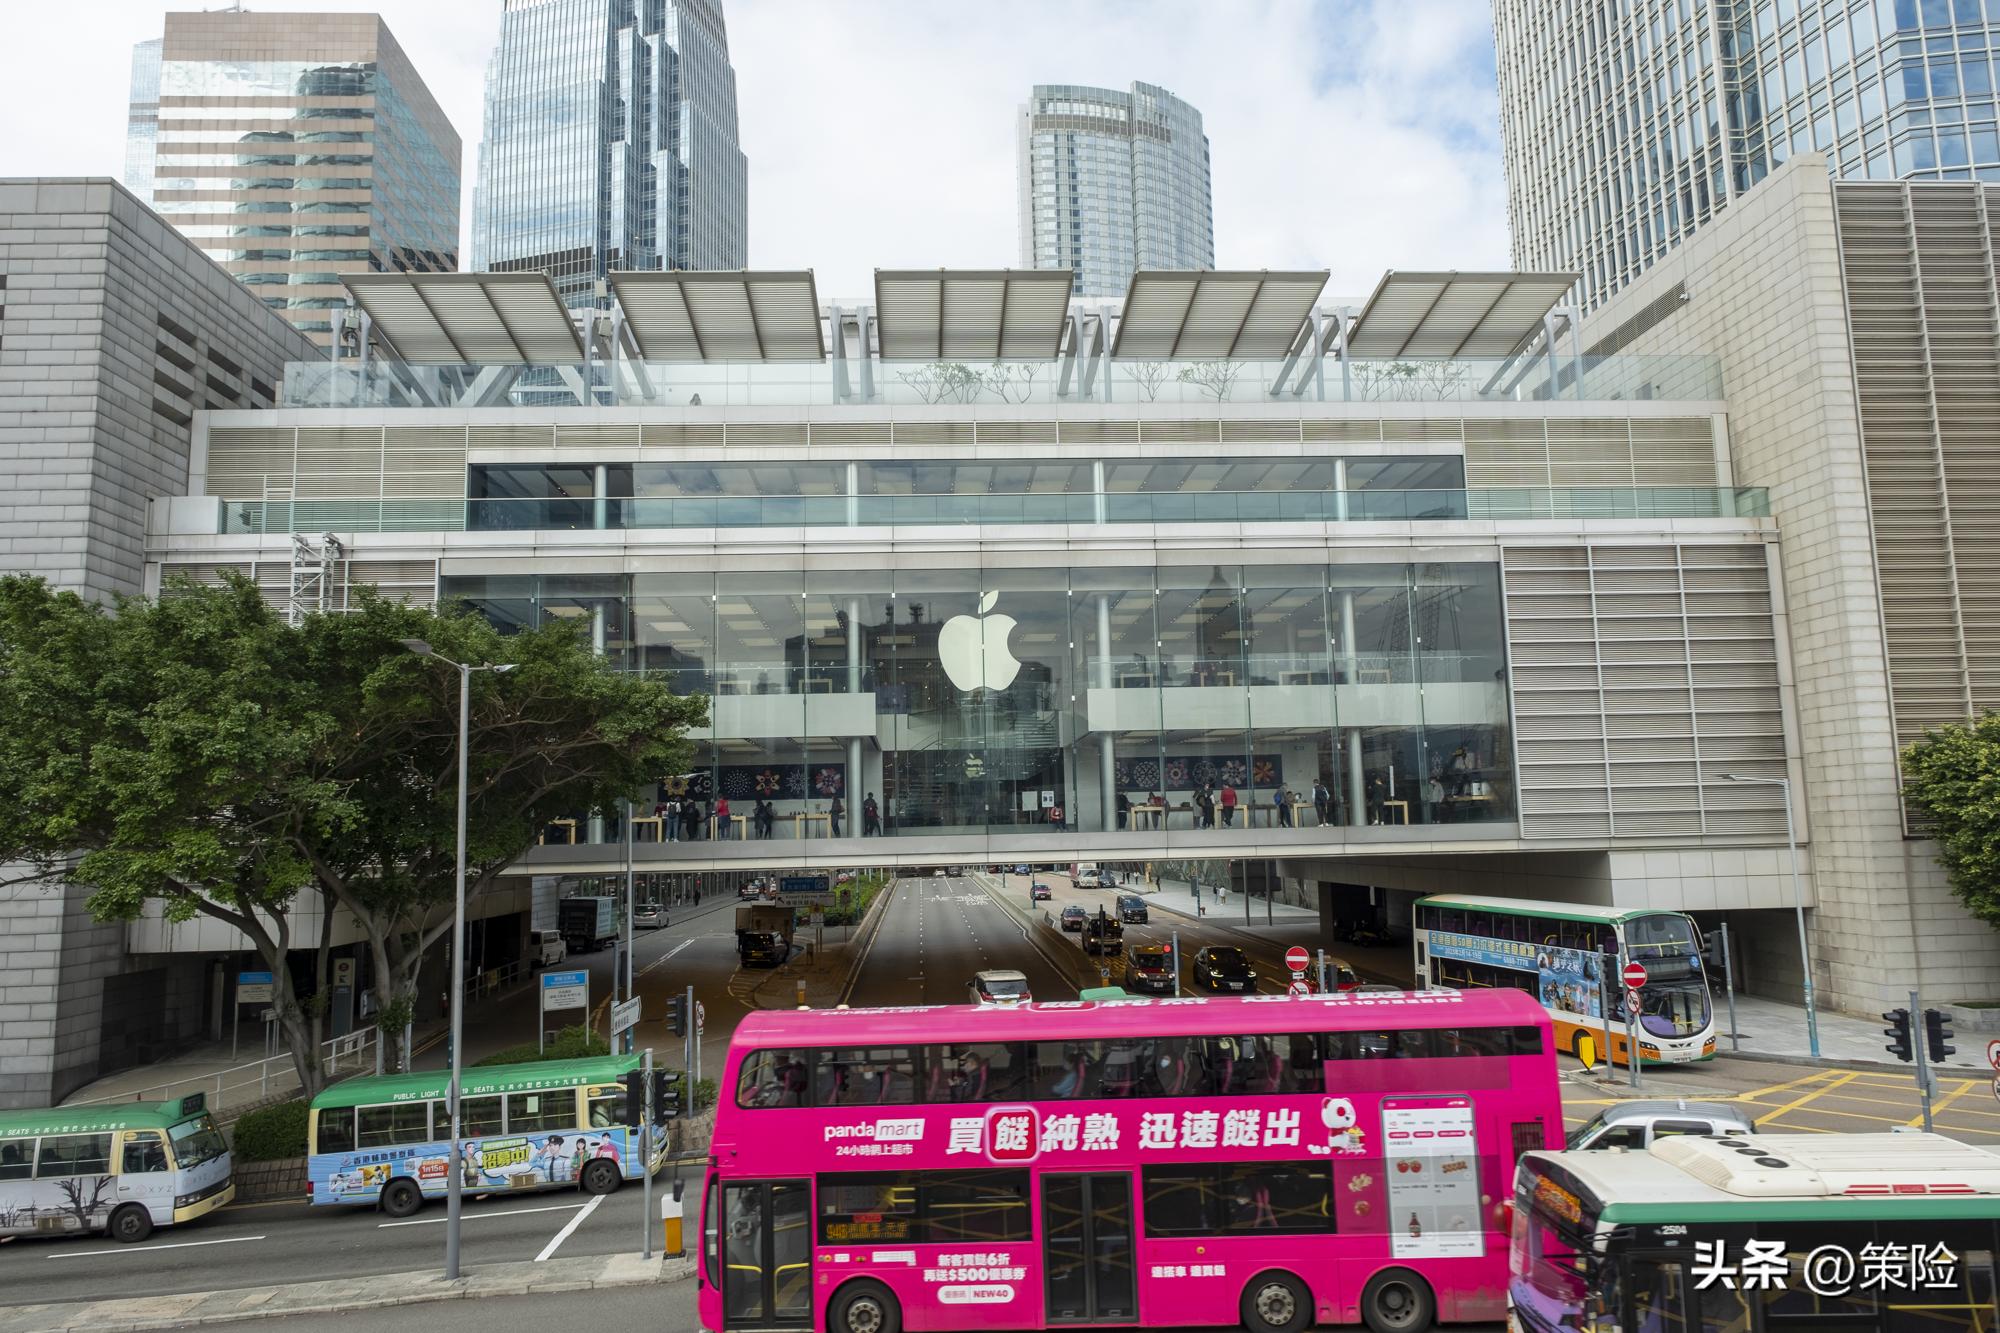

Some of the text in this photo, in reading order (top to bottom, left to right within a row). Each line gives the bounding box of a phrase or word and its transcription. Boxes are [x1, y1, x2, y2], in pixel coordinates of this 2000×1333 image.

[393, 1092, 416, 1101] PUBLIC
[420, 1090, 440, 1098] LIGHT
[473, 1085, 495, 1093] SEATS
[8, 1127, 30, 1137] SEATS
[835, 1143, 914, 1157] 24小時網上超市
